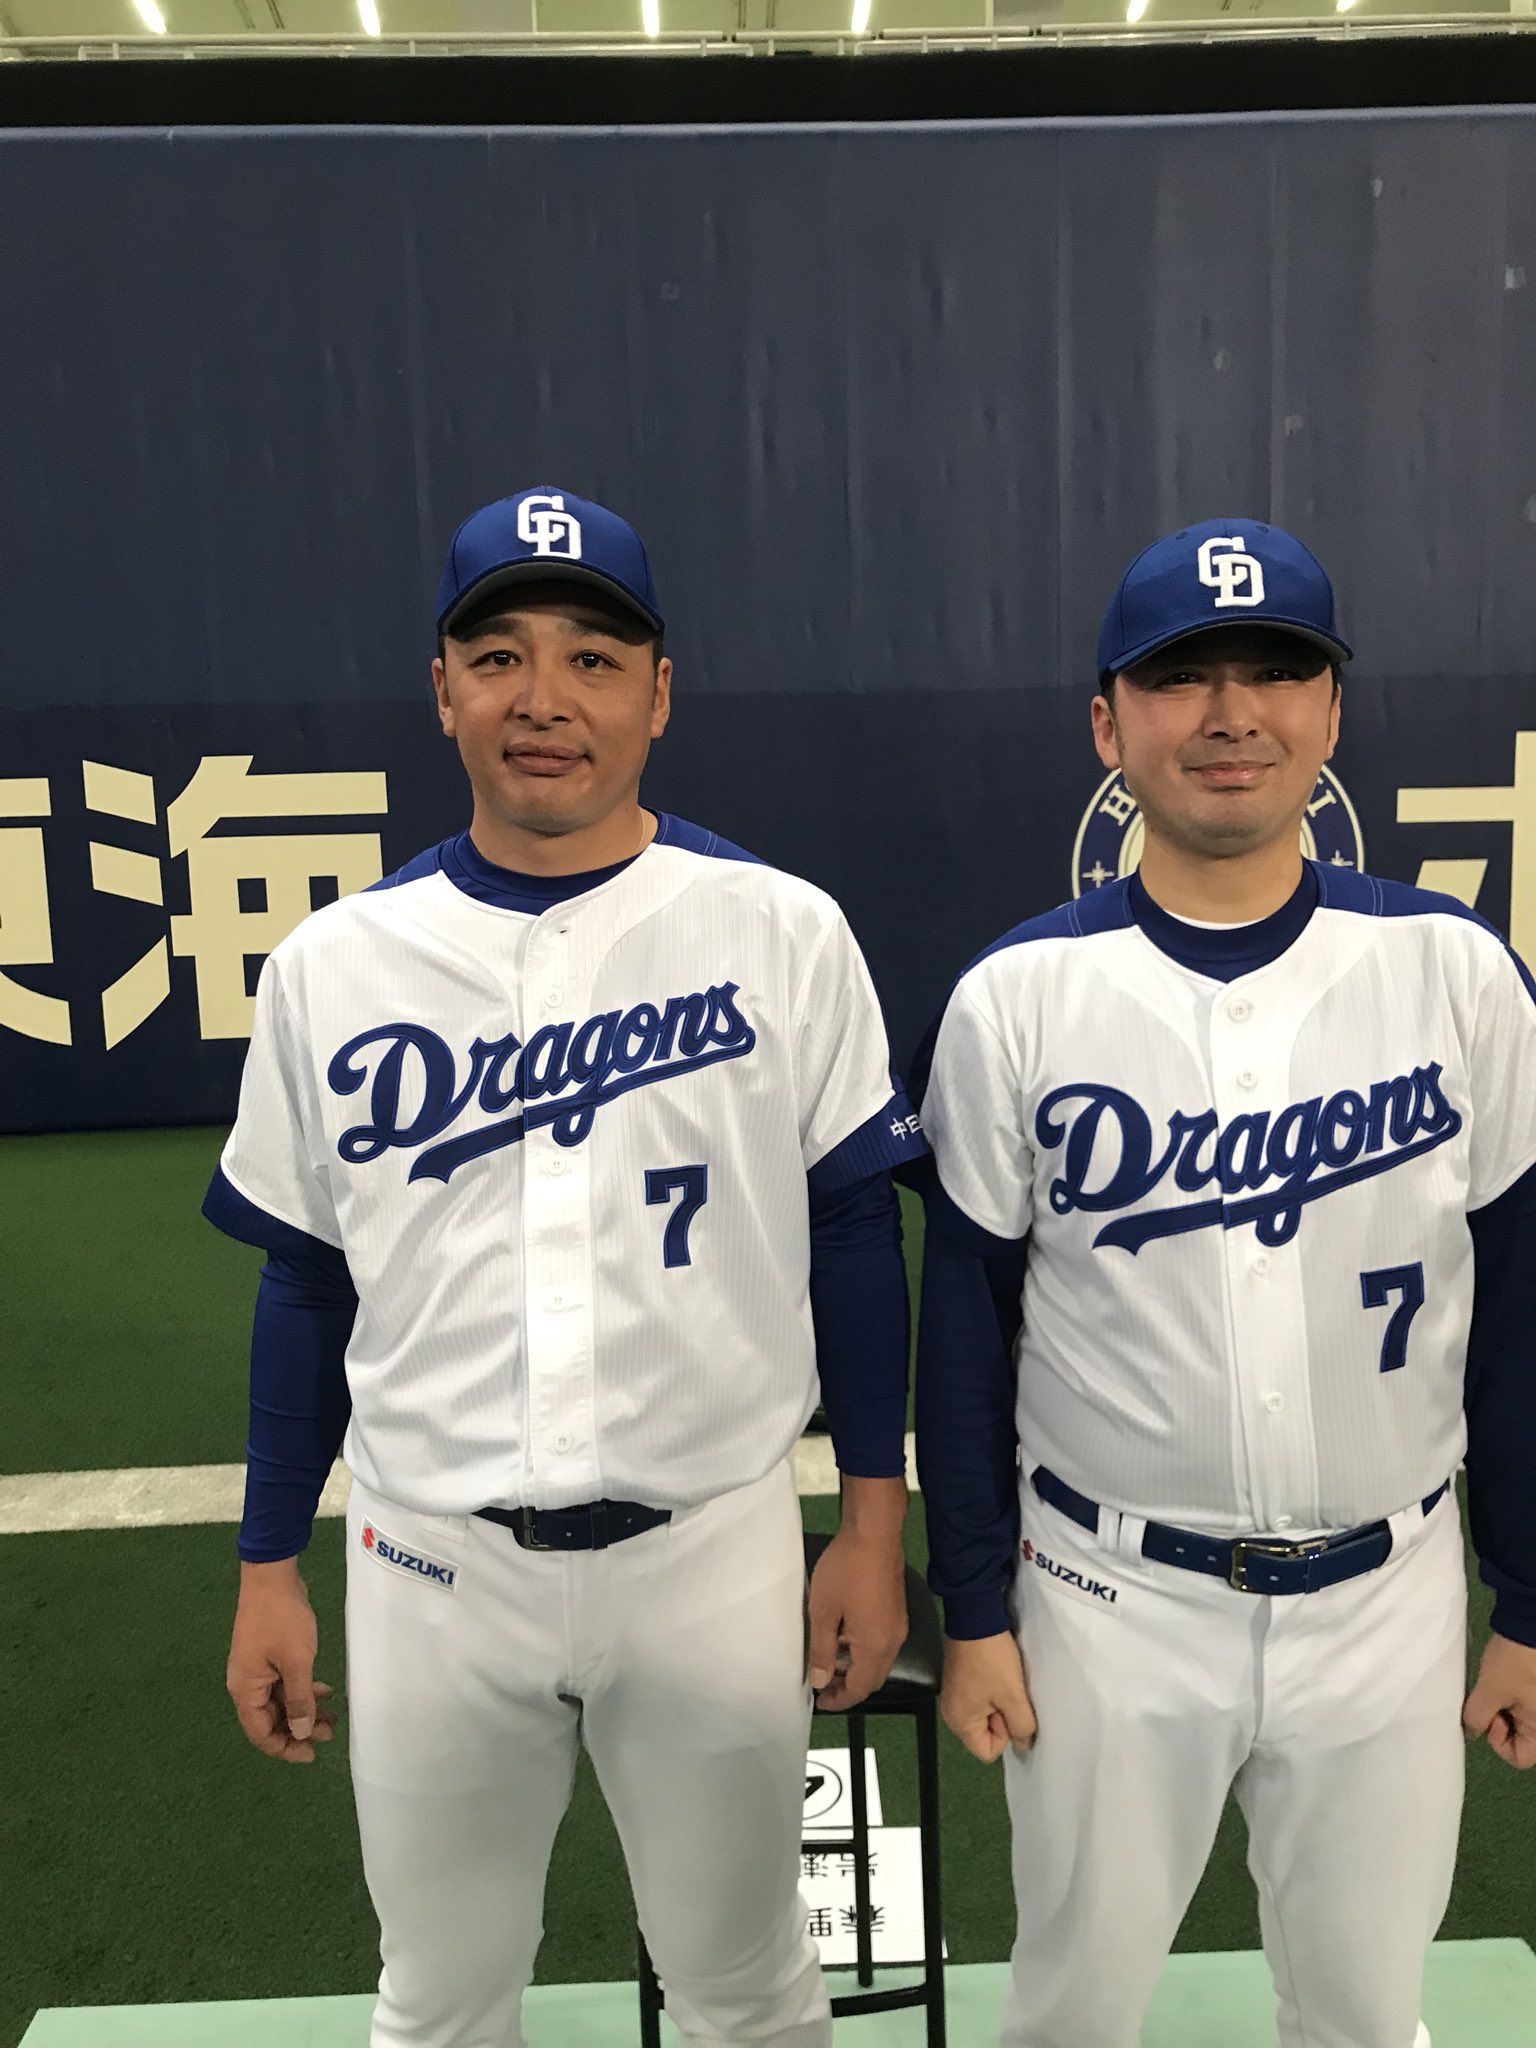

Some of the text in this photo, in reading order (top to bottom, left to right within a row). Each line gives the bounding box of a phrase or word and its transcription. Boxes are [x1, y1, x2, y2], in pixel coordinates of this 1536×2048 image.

[517, 495, 582, 560] CD
[1197, 536, 1265, 608] CD
[328, 981, 756, 1186] Dragons
[1035, 1061, 1462, 1256] Dragons
[644, 1164, 708, 1269] 7
[1360, 1261, 1424, 1373] 7
[376, 1540, 454, 1585] SUZUKI
[1035, 1552, 1117, 1603] SUZUKI
